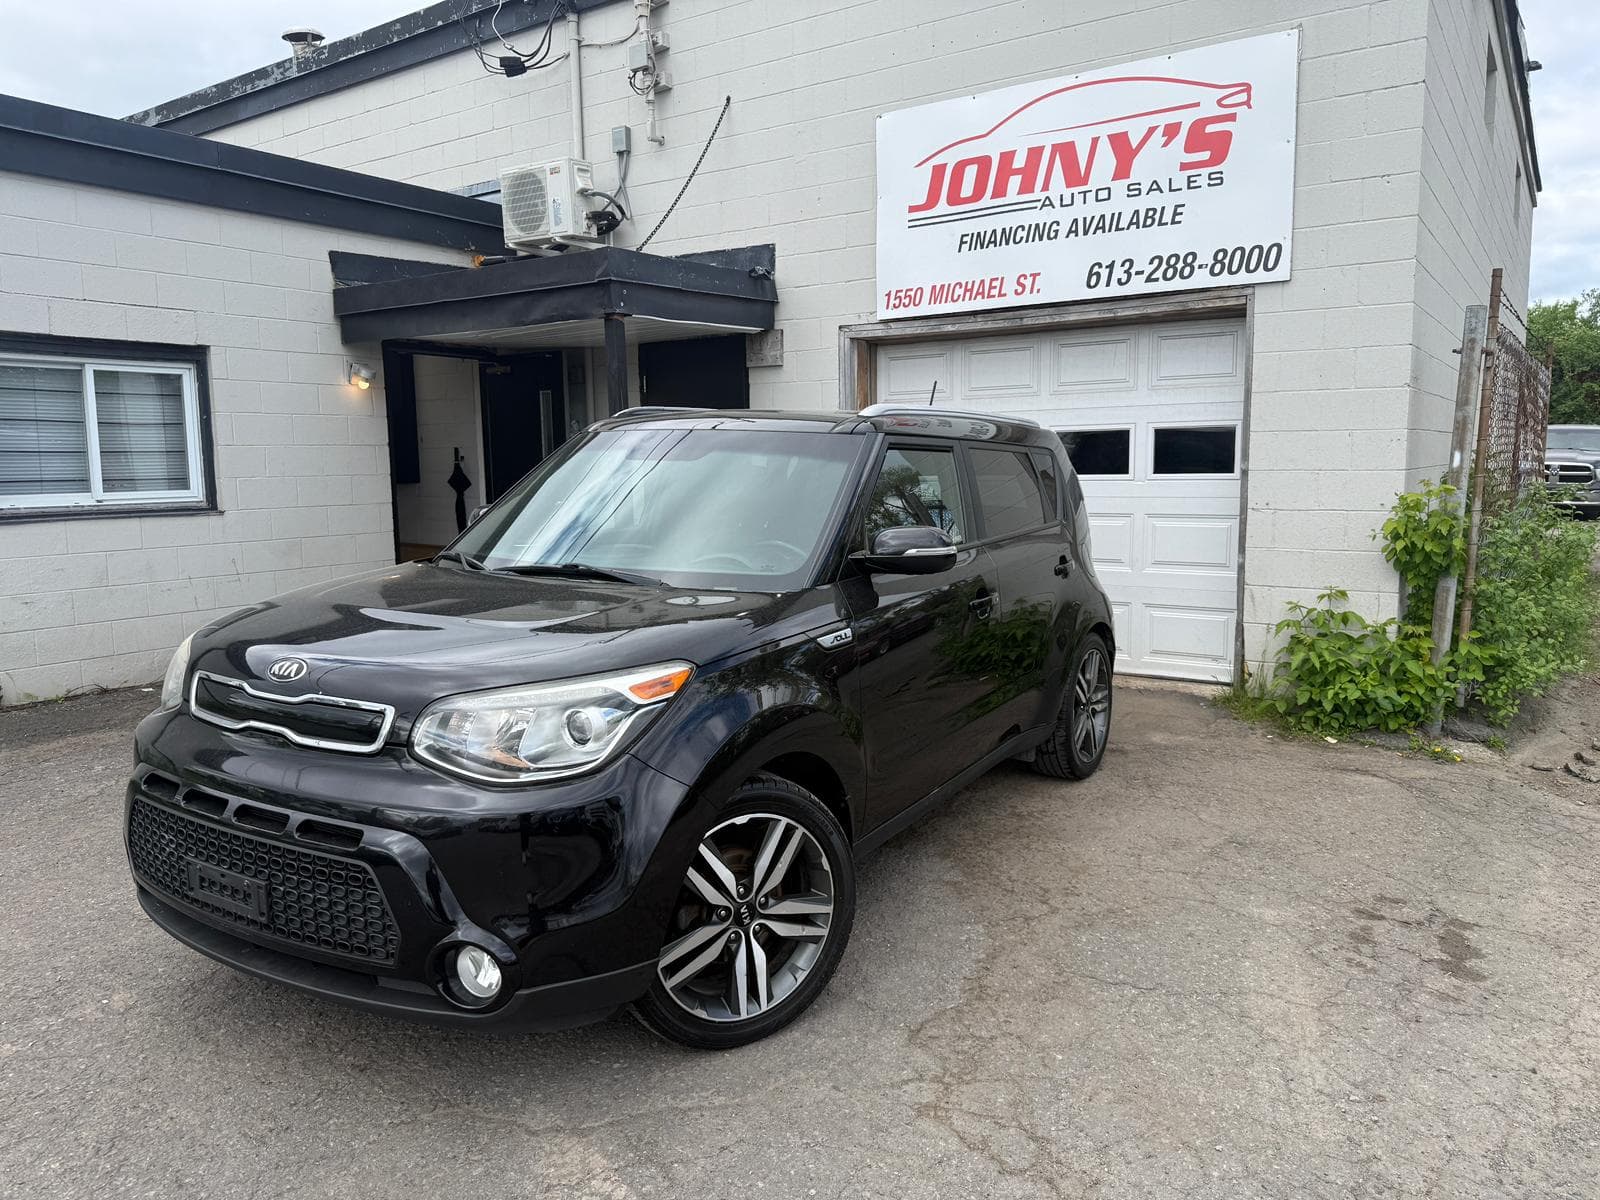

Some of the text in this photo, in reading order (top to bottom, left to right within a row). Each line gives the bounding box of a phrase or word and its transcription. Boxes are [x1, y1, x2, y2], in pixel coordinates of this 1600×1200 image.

[908, 112, 1237, 214] JOHNY'S
[1039, 171, 1225, 211] AUTO SALES
[957, 204, 1186, 253] FINANCING AVAILABLE
[1086, 242, 1283, 290] 613-288-8000
[884, 272, 1041, 310] 1550 MICHAEL ST.
[270, 660, 299, 678] KIA
